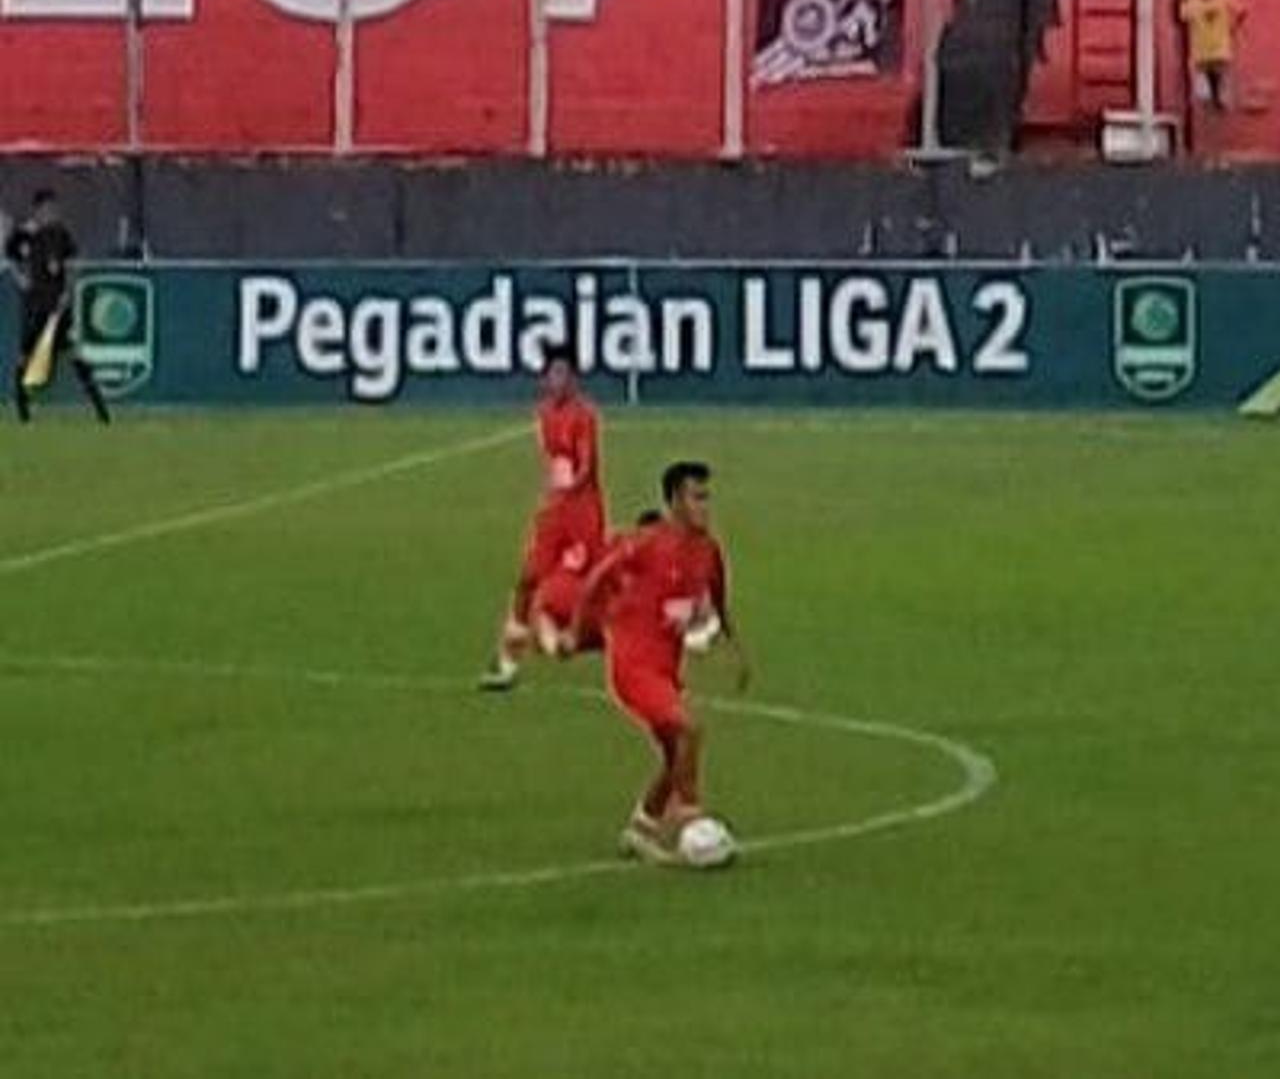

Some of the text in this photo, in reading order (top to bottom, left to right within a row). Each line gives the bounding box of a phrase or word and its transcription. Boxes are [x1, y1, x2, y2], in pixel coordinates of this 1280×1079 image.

[237, 274, 1029, 399] Pegadaian LIGA 2
